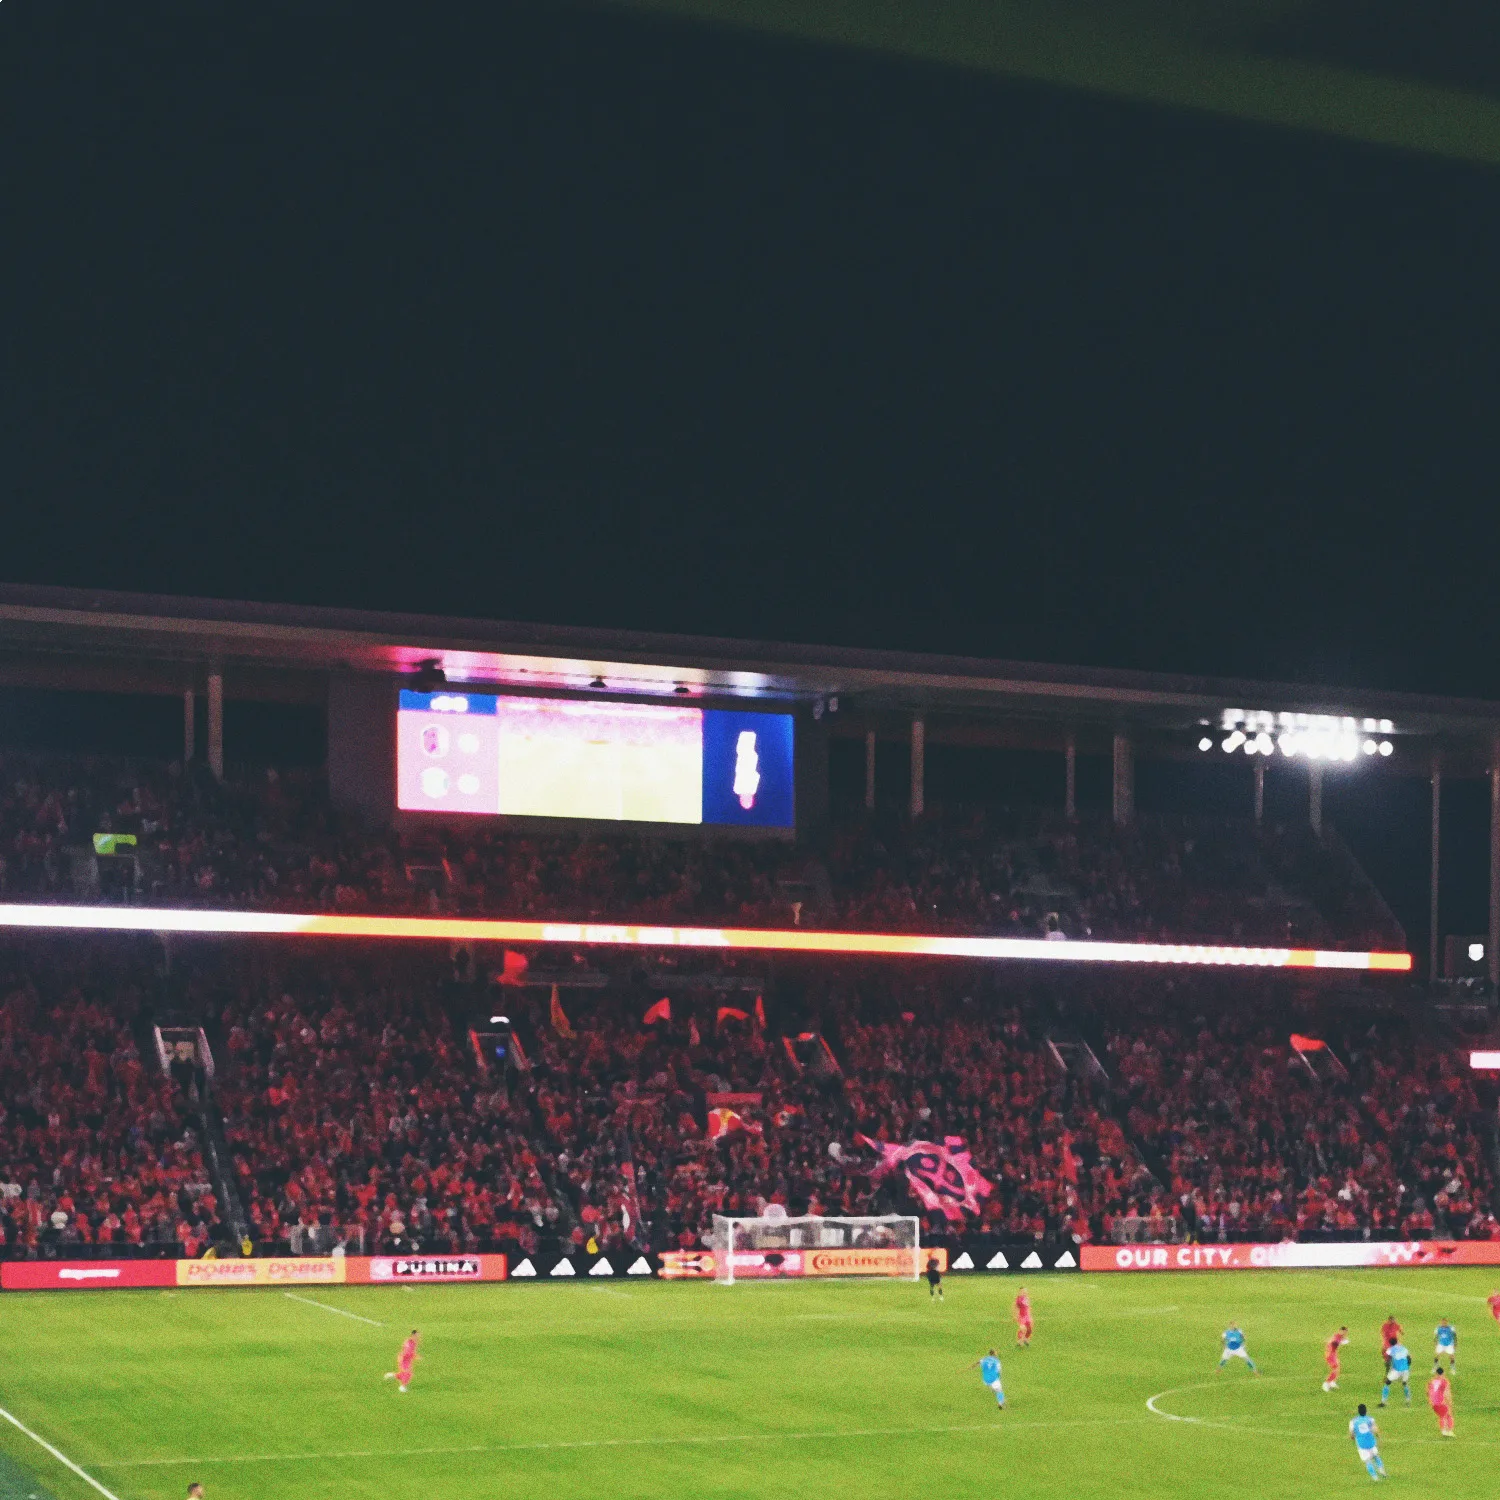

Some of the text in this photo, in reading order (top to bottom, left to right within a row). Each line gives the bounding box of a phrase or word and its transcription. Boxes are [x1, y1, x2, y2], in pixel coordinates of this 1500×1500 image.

[1115, 1249, 1169, 1267] OUR
[1176, 1248, 1239, 1267] CITY.
[396, 1260, 475, 1274] PURINA
